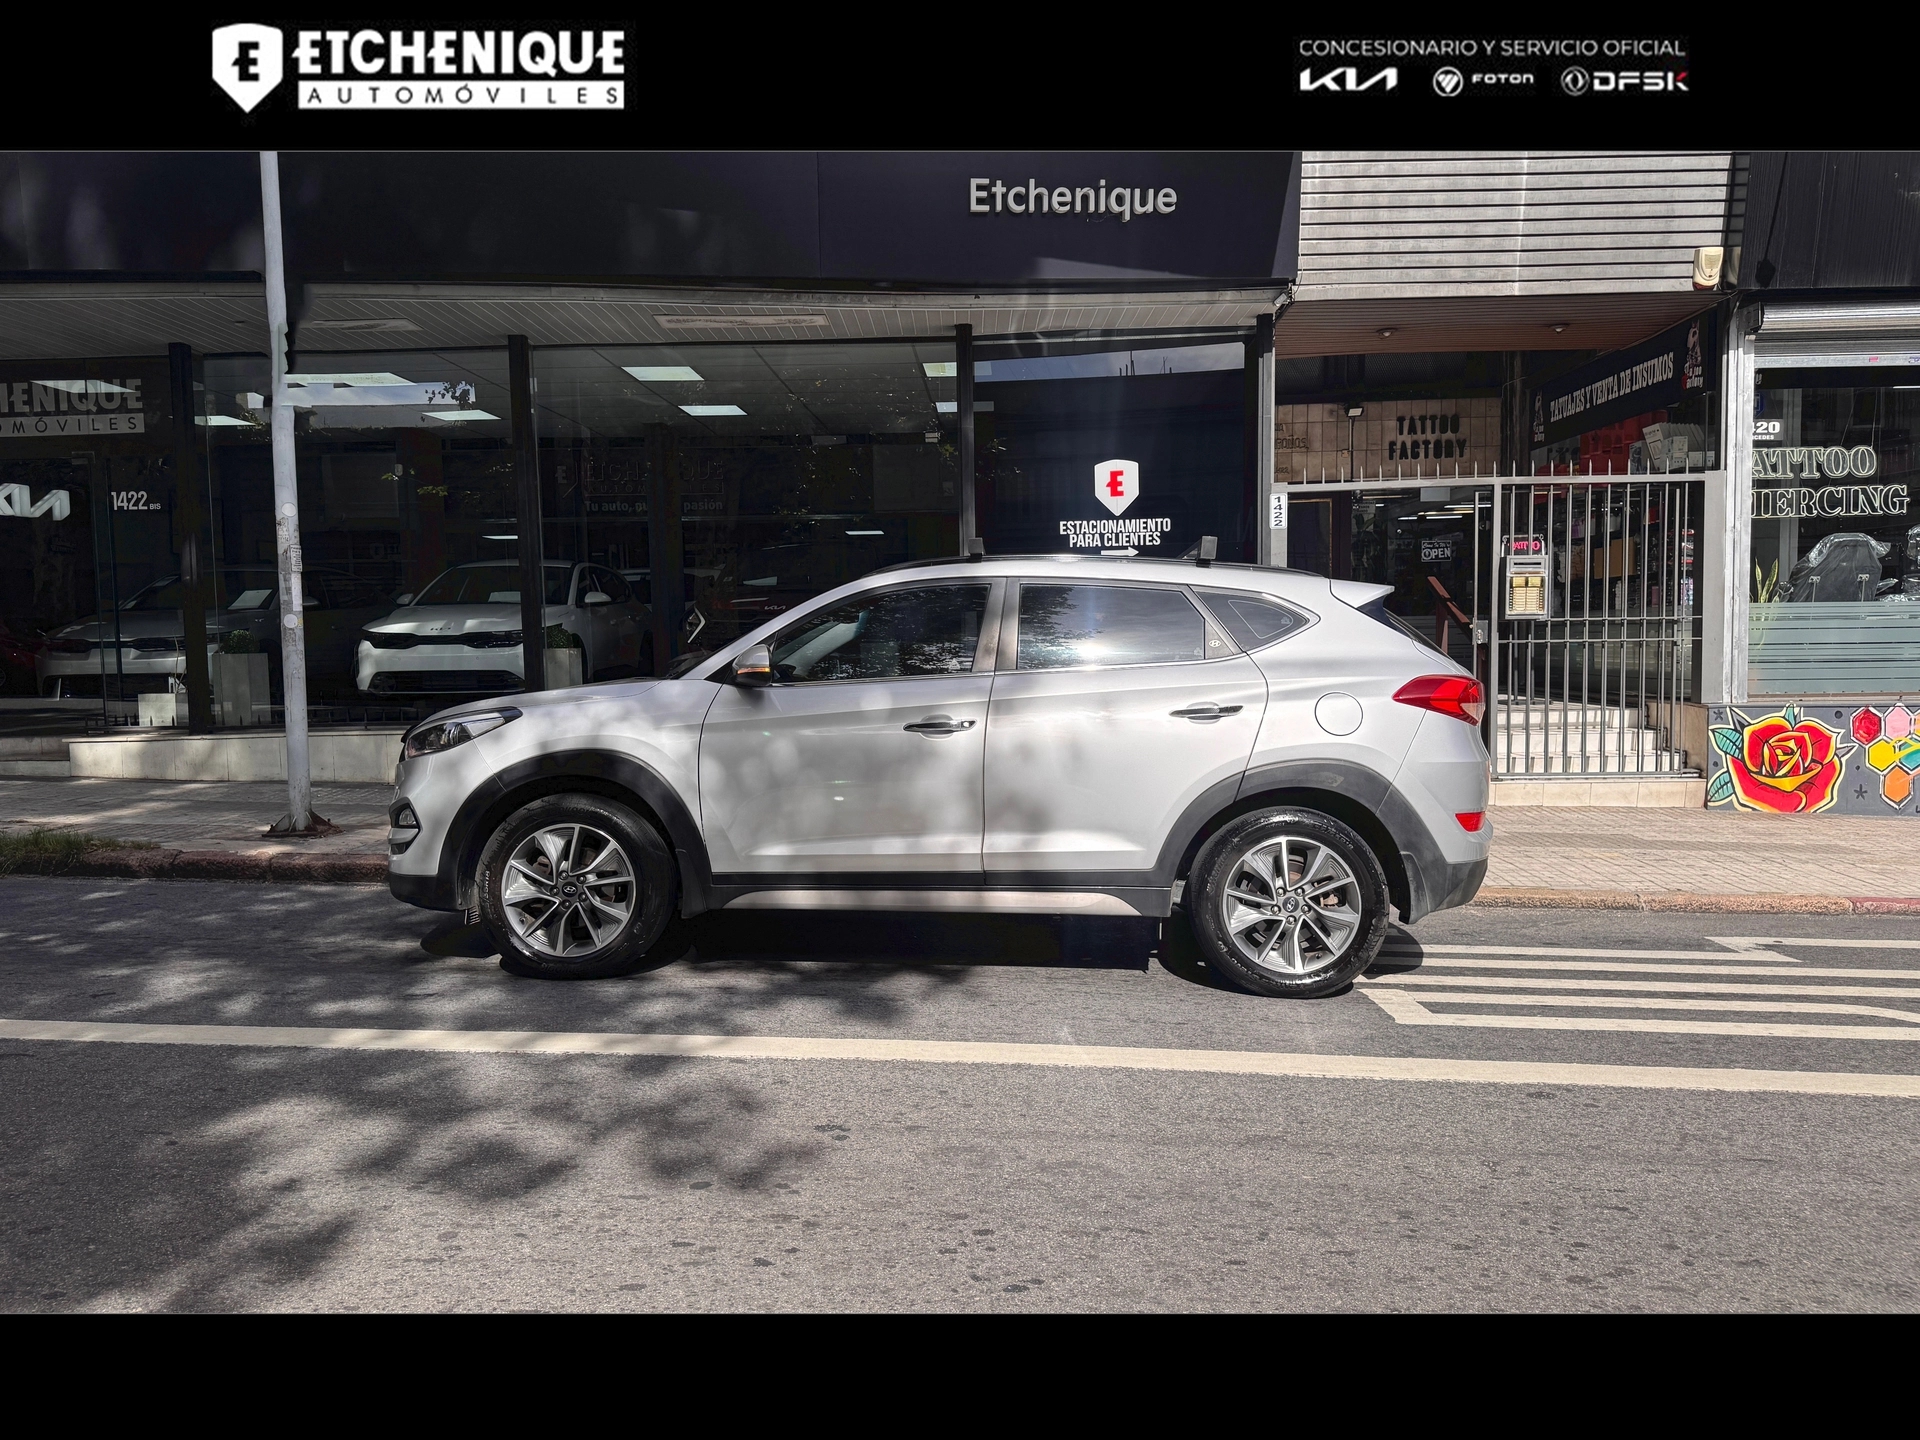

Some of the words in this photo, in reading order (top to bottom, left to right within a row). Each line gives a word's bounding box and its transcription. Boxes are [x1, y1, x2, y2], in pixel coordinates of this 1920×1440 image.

[969, 178, 1177, 223] Etchenique
[1550, 387, 1585, 423] TATUAJES
[1585, 383, 1592, 409] Y
[1592, 374, 1619, 406] VENTA
[1619, 367, 1631, 396] DE
[1632, 351, 1674, 390] INSUMOS
[0, 416, 137, 435] MÓVILES
[1396, 414, 1460, 436] TATTOO
[1388, 439, 1467, 461] FACTORY
[111, 490, 148, 511] 1422
[683, 499, 723, 513] pasión
[1750, 484, 1910, 519] IERCING
[1272, 496, 1284, 527] 1422
[1059, 518, 1171, 535] ESTACIONAMIENTO
[1069, 533, 1101, 548] PARA
[1104, 532, 1161, 547] CLIENTES
[1422, 547, 1451, 560] OPEN
